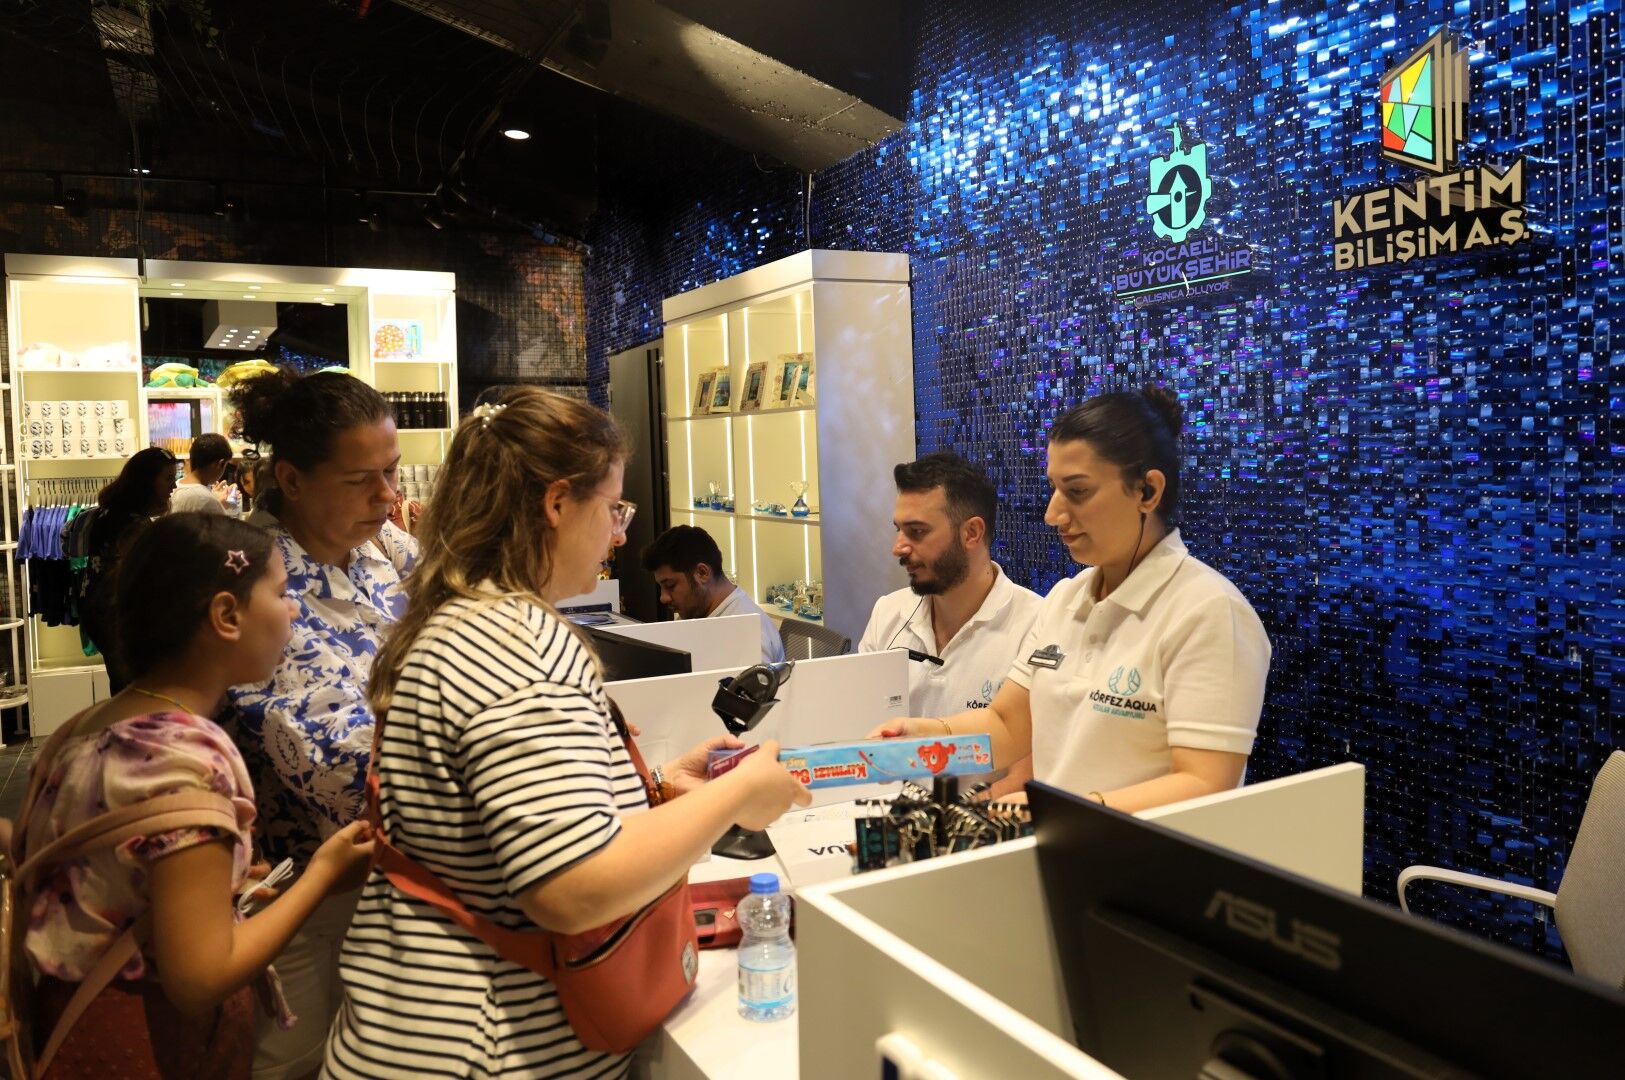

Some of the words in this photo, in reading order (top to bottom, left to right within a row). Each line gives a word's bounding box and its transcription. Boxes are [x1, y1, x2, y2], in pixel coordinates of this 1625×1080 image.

[1463, 209, 1530, 250] A.Ş.
[1187, 280, 1230, 297] OLUYOR
[1124, 698, 1158, 713] AQUA
[1204, 890, 1342, 970] ASUS
